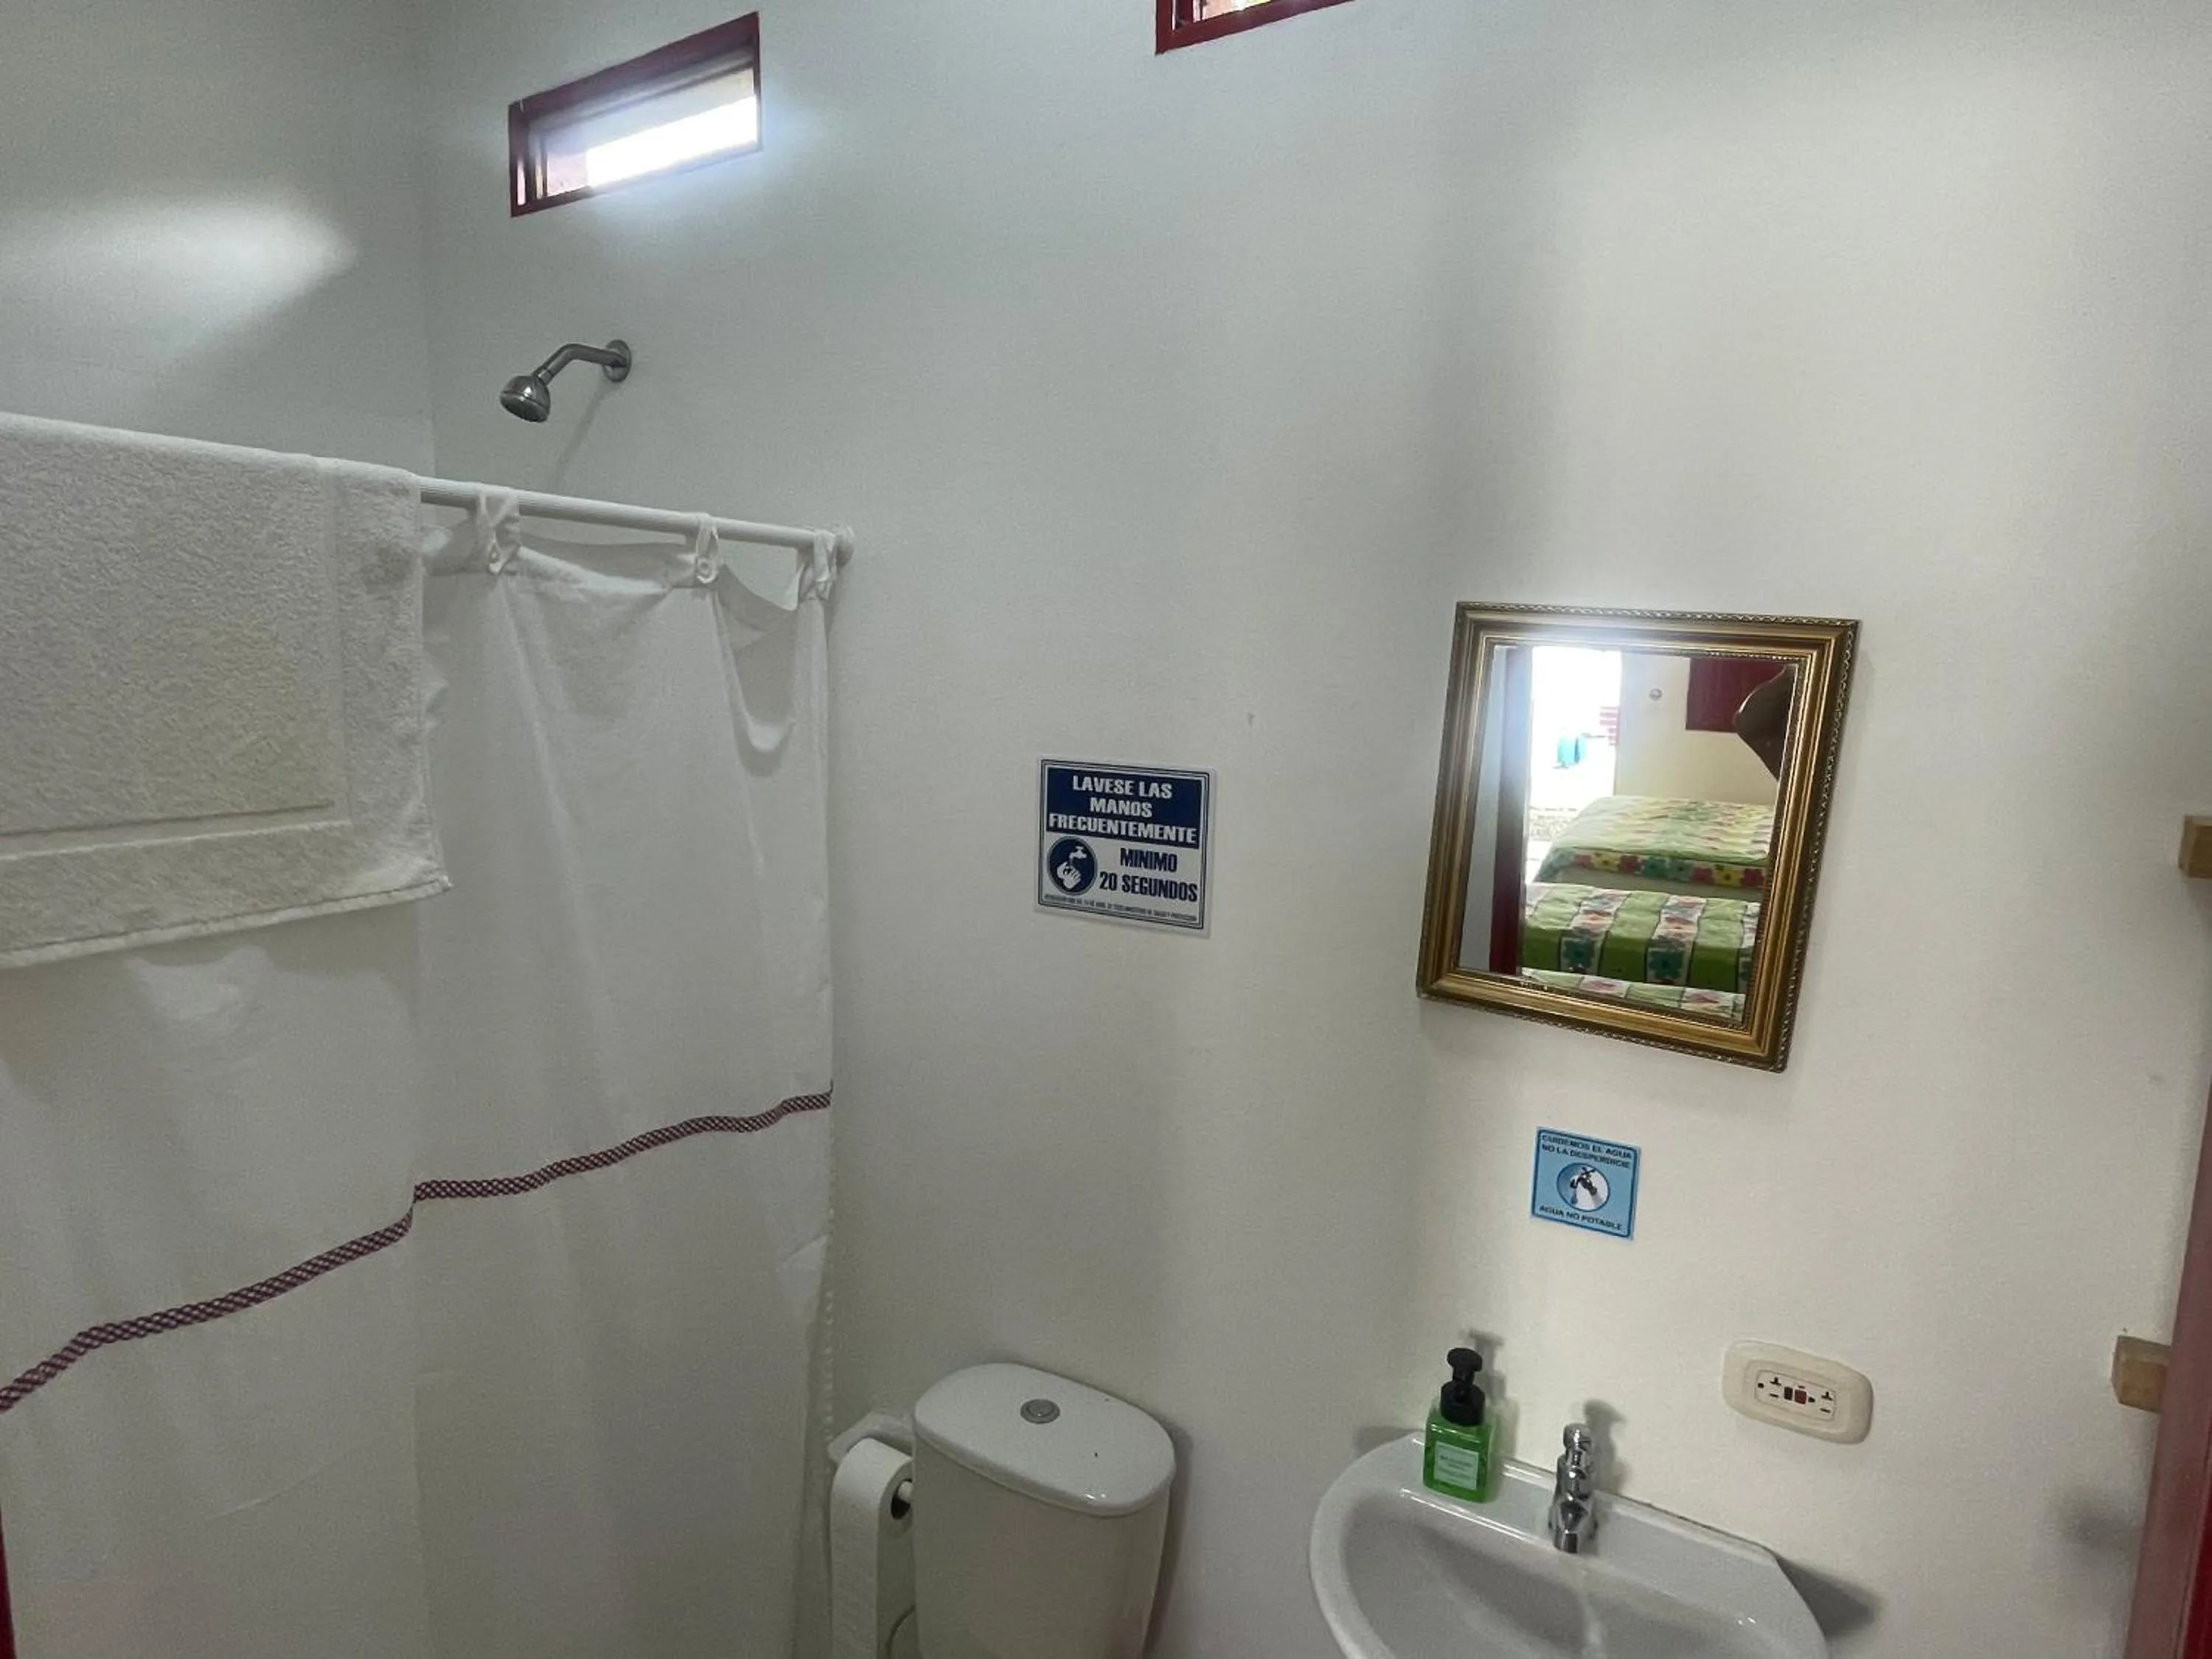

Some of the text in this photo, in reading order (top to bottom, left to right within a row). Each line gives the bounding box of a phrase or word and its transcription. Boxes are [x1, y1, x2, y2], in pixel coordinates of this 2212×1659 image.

[1073, 775, 1172, 799] LAVESE LAS
[1090, 796, 1152, 818] MANOS
[1048, 813, 1197, 844] FRECUENTEMENTE
[1120, 847, 1178, 873] MINIMO
[1099, 871, 1198, 902] 20 SEGUNDOS
[1542, 1144, 1555, 1152] NO
[1557, 1147, 1569, 1155] LA
[1605, 1147, 1632, 1159] AGUA
[1540, 1205, 1622, 1231] AGUA NO POTABLE
